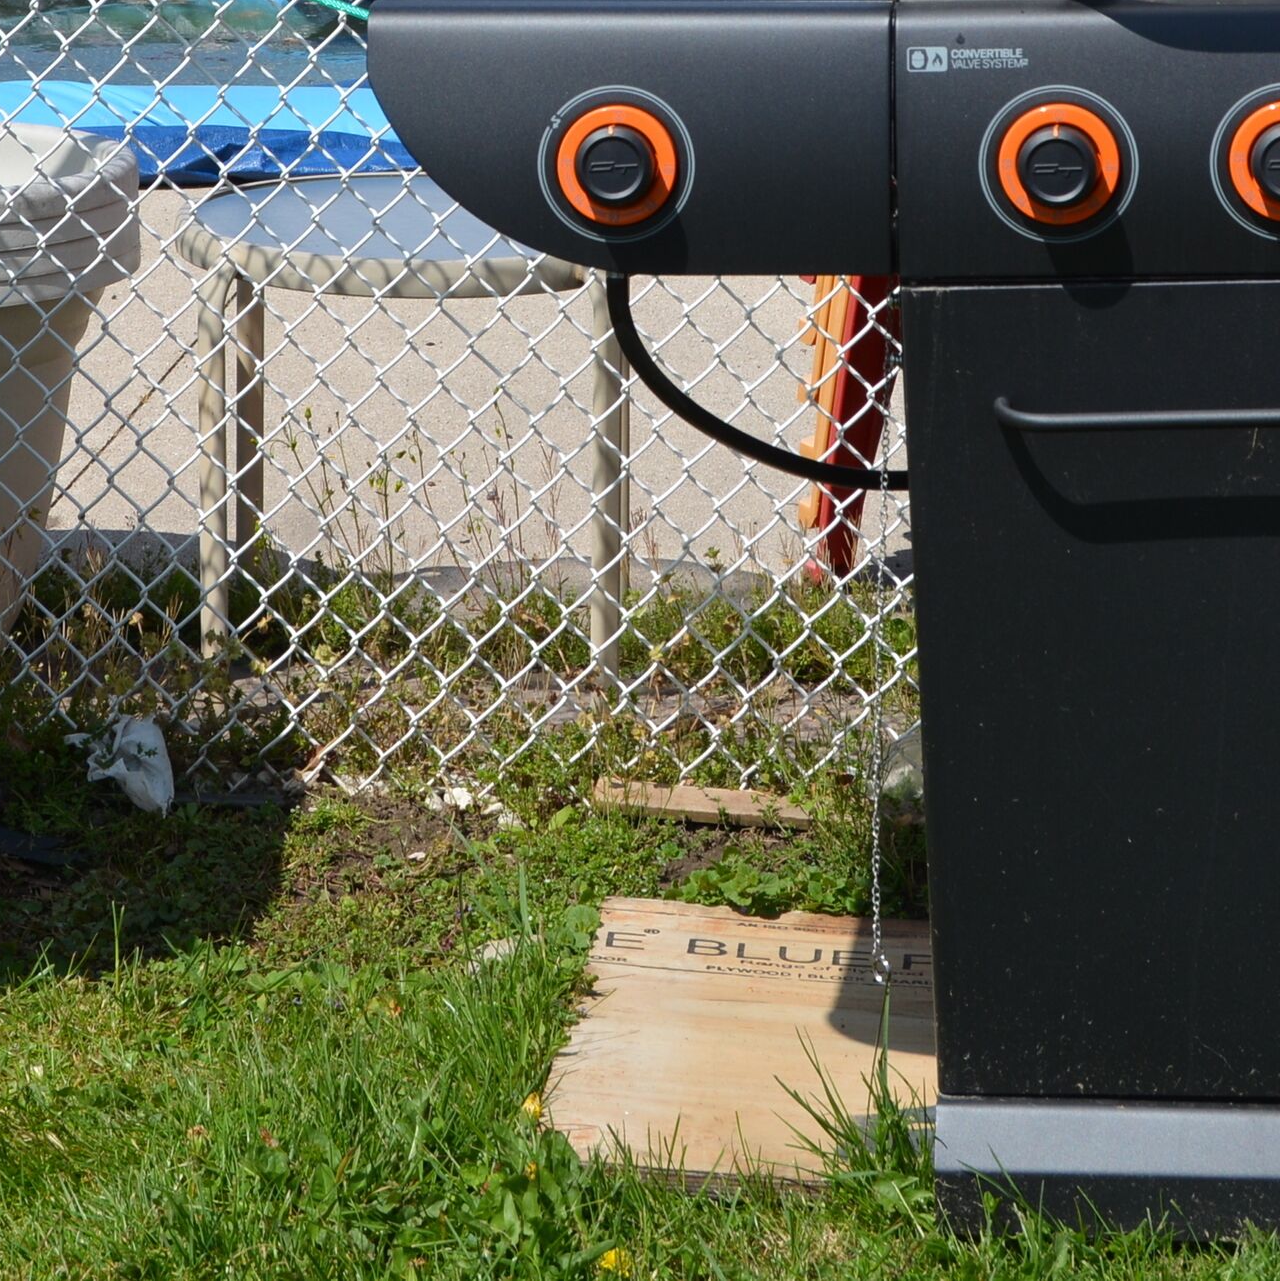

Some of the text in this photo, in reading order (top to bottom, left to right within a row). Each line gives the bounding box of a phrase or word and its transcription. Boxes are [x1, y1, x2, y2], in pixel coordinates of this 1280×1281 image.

[951, 48, 1023, 59] CONVERTIBLE
[951, 59, 980, 69] VALVE
[686, 938, 873, 967] BLUE
[705, 965, 792, 977] PLYWOOD
